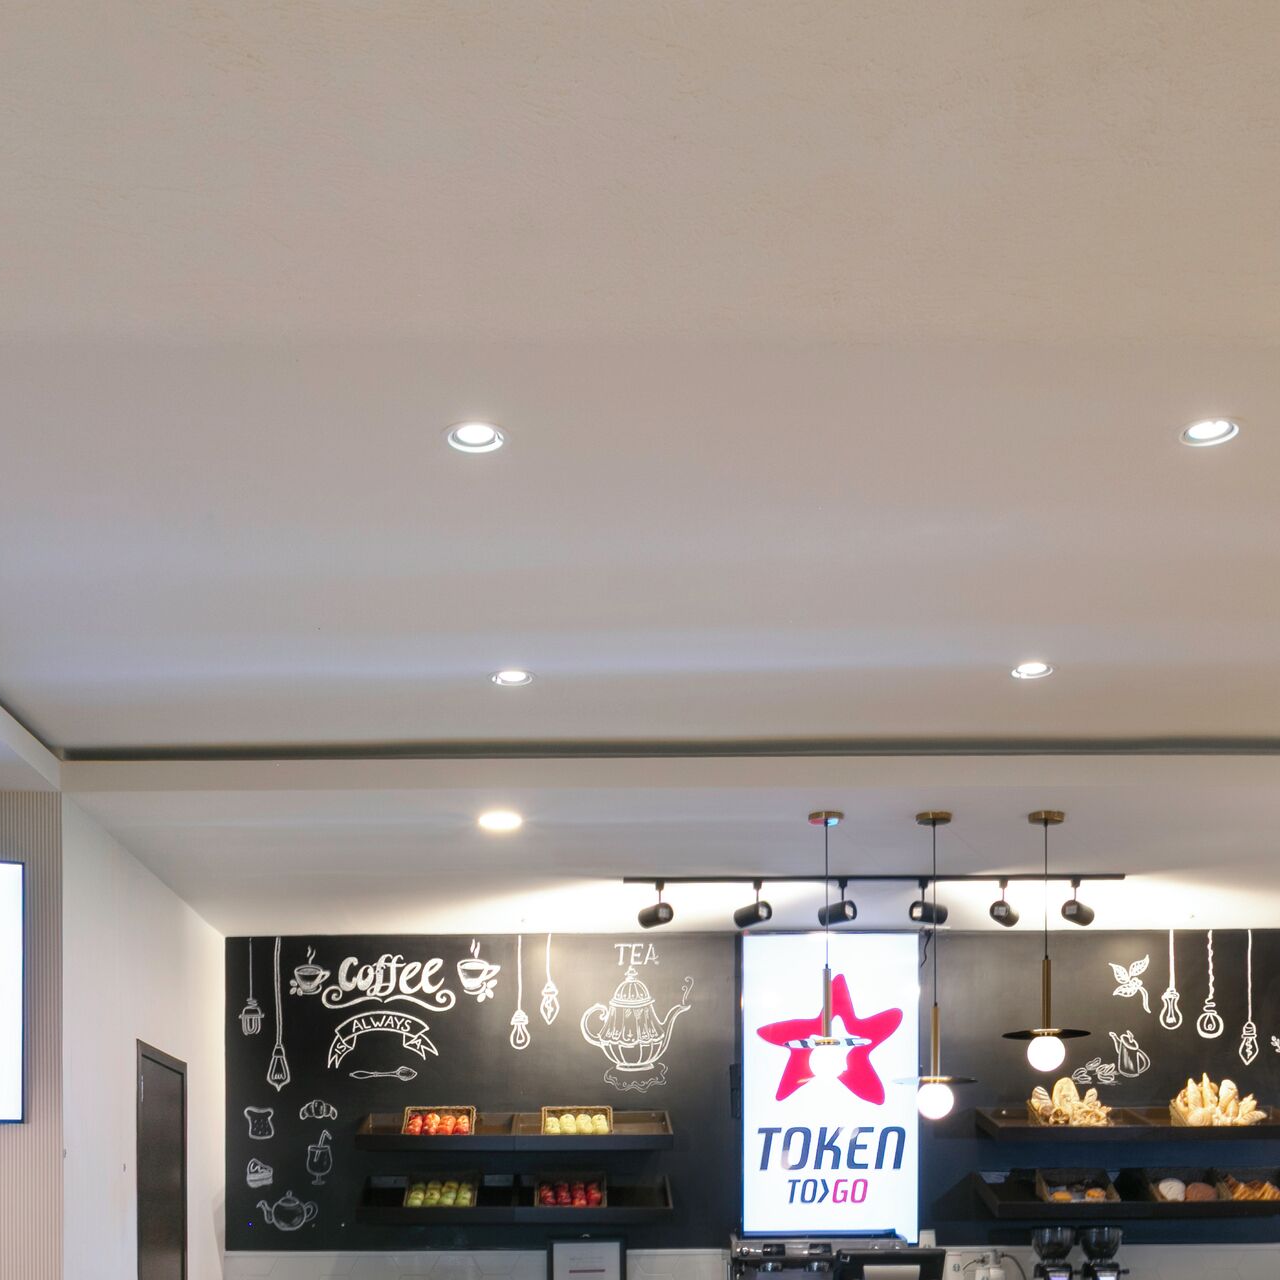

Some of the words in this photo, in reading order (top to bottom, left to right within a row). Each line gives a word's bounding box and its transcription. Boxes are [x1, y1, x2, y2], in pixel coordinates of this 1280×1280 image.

[614, 943, 659, 966] TEA
[338, 954, 445, 997] Coffee
[334, 1042, 347, 1054] IS
[352, 1015, 412, 1032] ALWAYS
[410, 1038, 422, 1050] A
[757, 1126, 906, 1170] TOKEN
